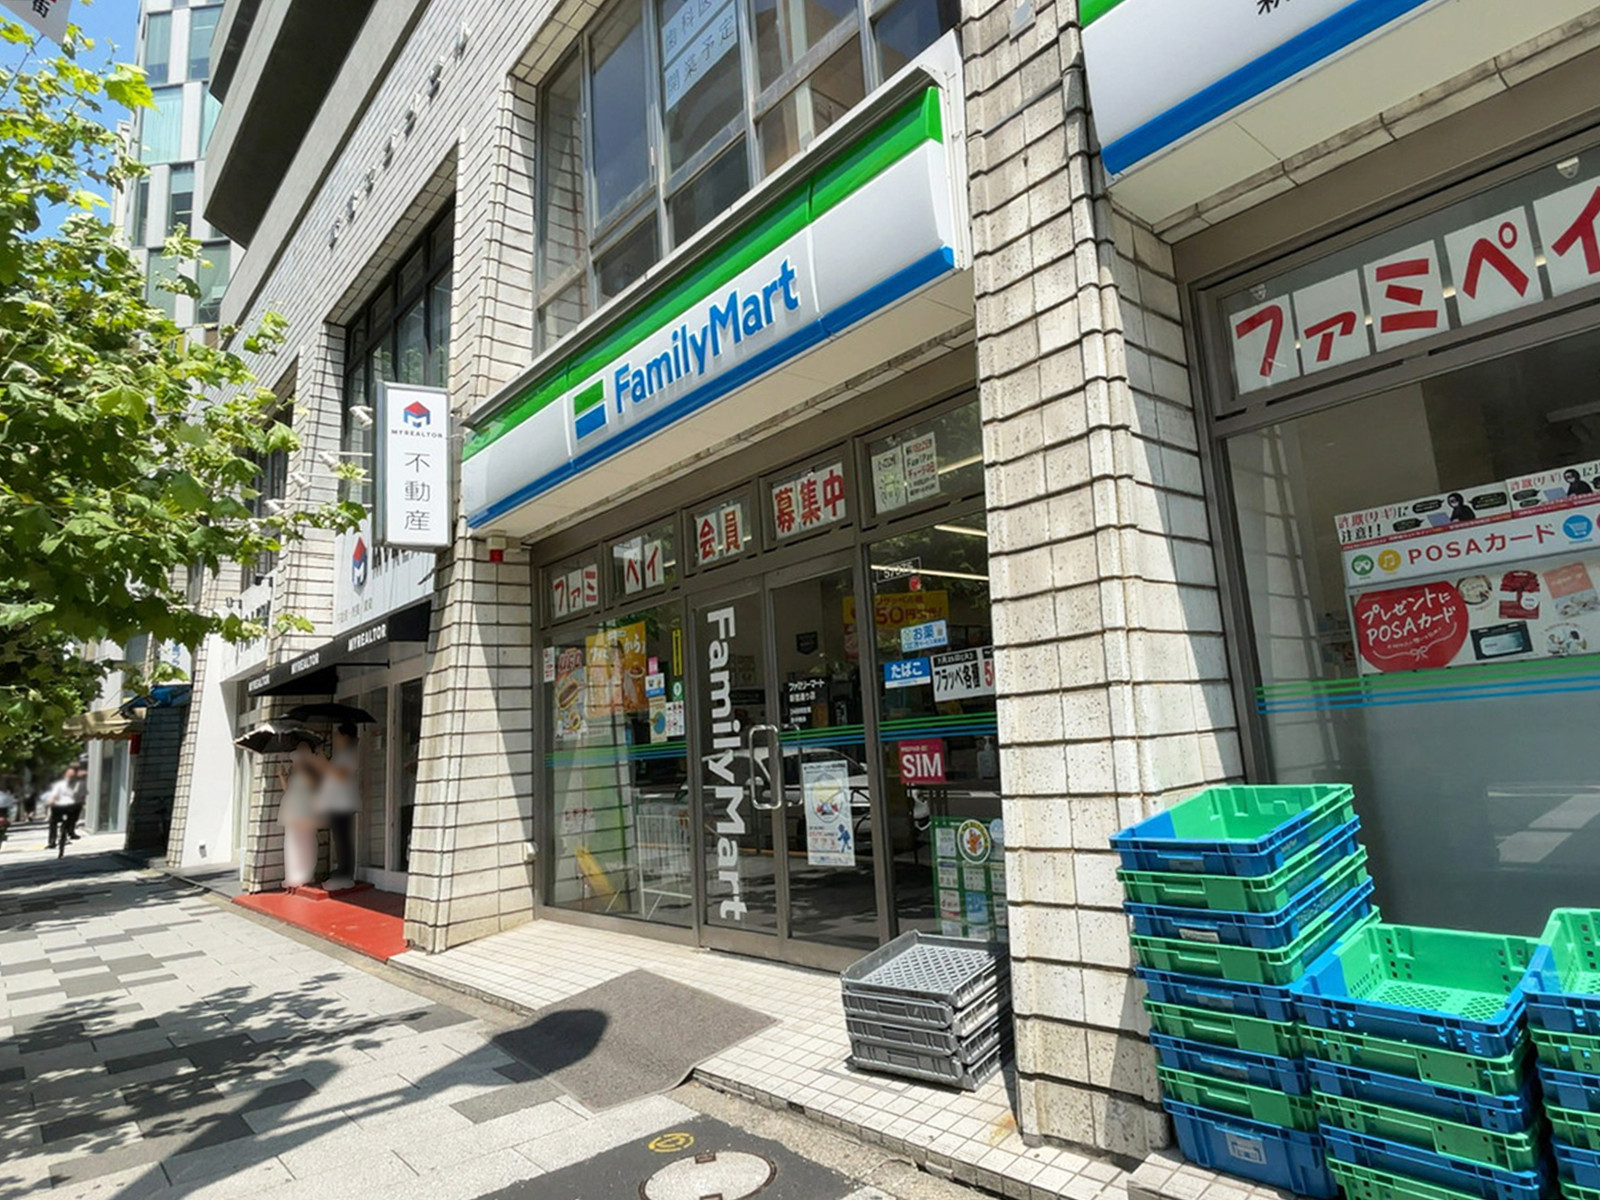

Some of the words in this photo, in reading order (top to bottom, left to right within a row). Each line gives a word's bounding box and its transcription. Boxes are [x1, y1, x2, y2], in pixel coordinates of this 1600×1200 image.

[614, 258, 799, 414] FamilyMart
[391, 429, 443, 438] MYREALTOR
[405, 452, 431, 532] 不動産
[553, 567, 599, 614] ファミ
[624, 545, 659, 587] ペイ
[698, 505, 744, 561] 会員
[773, 468, 845, 533] 募集中
[1407, 524, 1556, 565] POSAカード
[1361, 587, 1451, 625] プレゼントに
[348, 624, 387, 652] MYREALTOR
[1366, 606, 1456, 647] POSAカード
[291, 652, 320, 674] MYREALTOR
[890, 661, 923, 679] たばこ
[934, 663, 981, 692] フラッペ各種
[707, 606, 747, 921] FamilyMart
[902, 753, 942, 778] SIM
